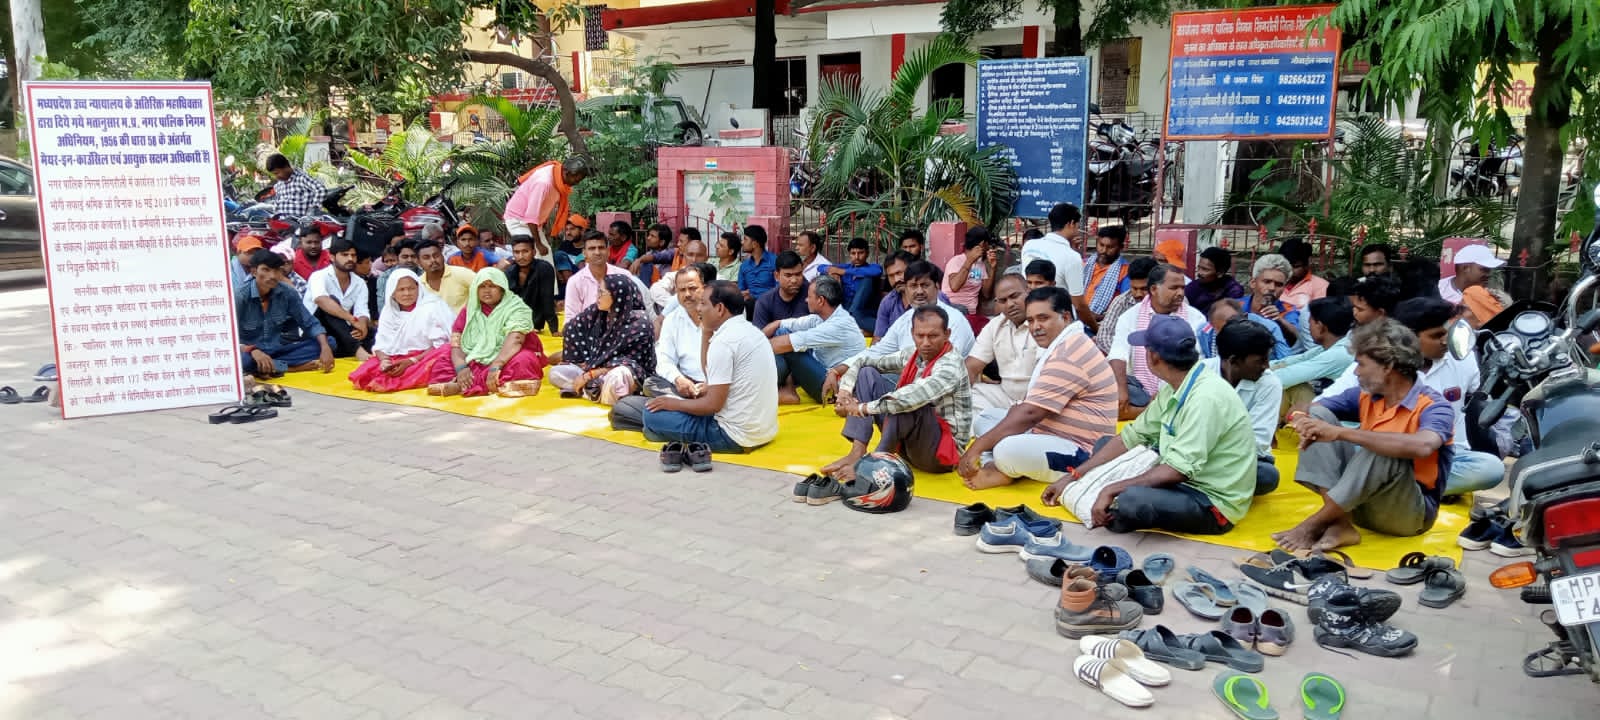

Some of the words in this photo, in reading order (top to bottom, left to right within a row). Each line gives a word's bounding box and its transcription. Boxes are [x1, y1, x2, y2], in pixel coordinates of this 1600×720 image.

[37, 96, 72, 110] मध्यप्रदेश
[73, 98, 87, 109] उच्च
[89, 98, 123, 110] न्यायालय
[125, 95, 133, 109] के
[134, 95, 164, 109] अतिरिक्त
[166, 95, 203, 109] महाधिवक्ता
[1278, 94, 1325, 105] 9425179118
[54, 114, 70, 128] दिये
[71, 114, 85, 128] गये
[86, 117, 120, 132] मतानुसार
[141, 116, 158, 128] नगर
[159, 114, 184, 128] पालिक
[185, 114, 206, 127] निगम
[1276, 115, 1324, 126] 9425031342
[57, 133, 99, 149] अधिनियम,
[101, 135, 118, 147] 1956
[119, 132, 129, 146] की
[131, 135, 146, 146] धारा
[148, 135, 157, 146] 58
[158, 132, 166, 145] के
[167, 131, 193, 145] अंतर्गत
[110, 151, 121, 165] एवं
[123, 153, 147, 168] आयुक्त
[149, 153, 168, 165] सक्षम
[170, 150, 201, 164] अधिकारी
[48, 179, 61, 189] नगर
[63, 176, 83, 189] पालिक
[84, 176, 100, 189] निगम
[135, 199, 142, 208] 16
[1568, 575, 1600, 599] MP
